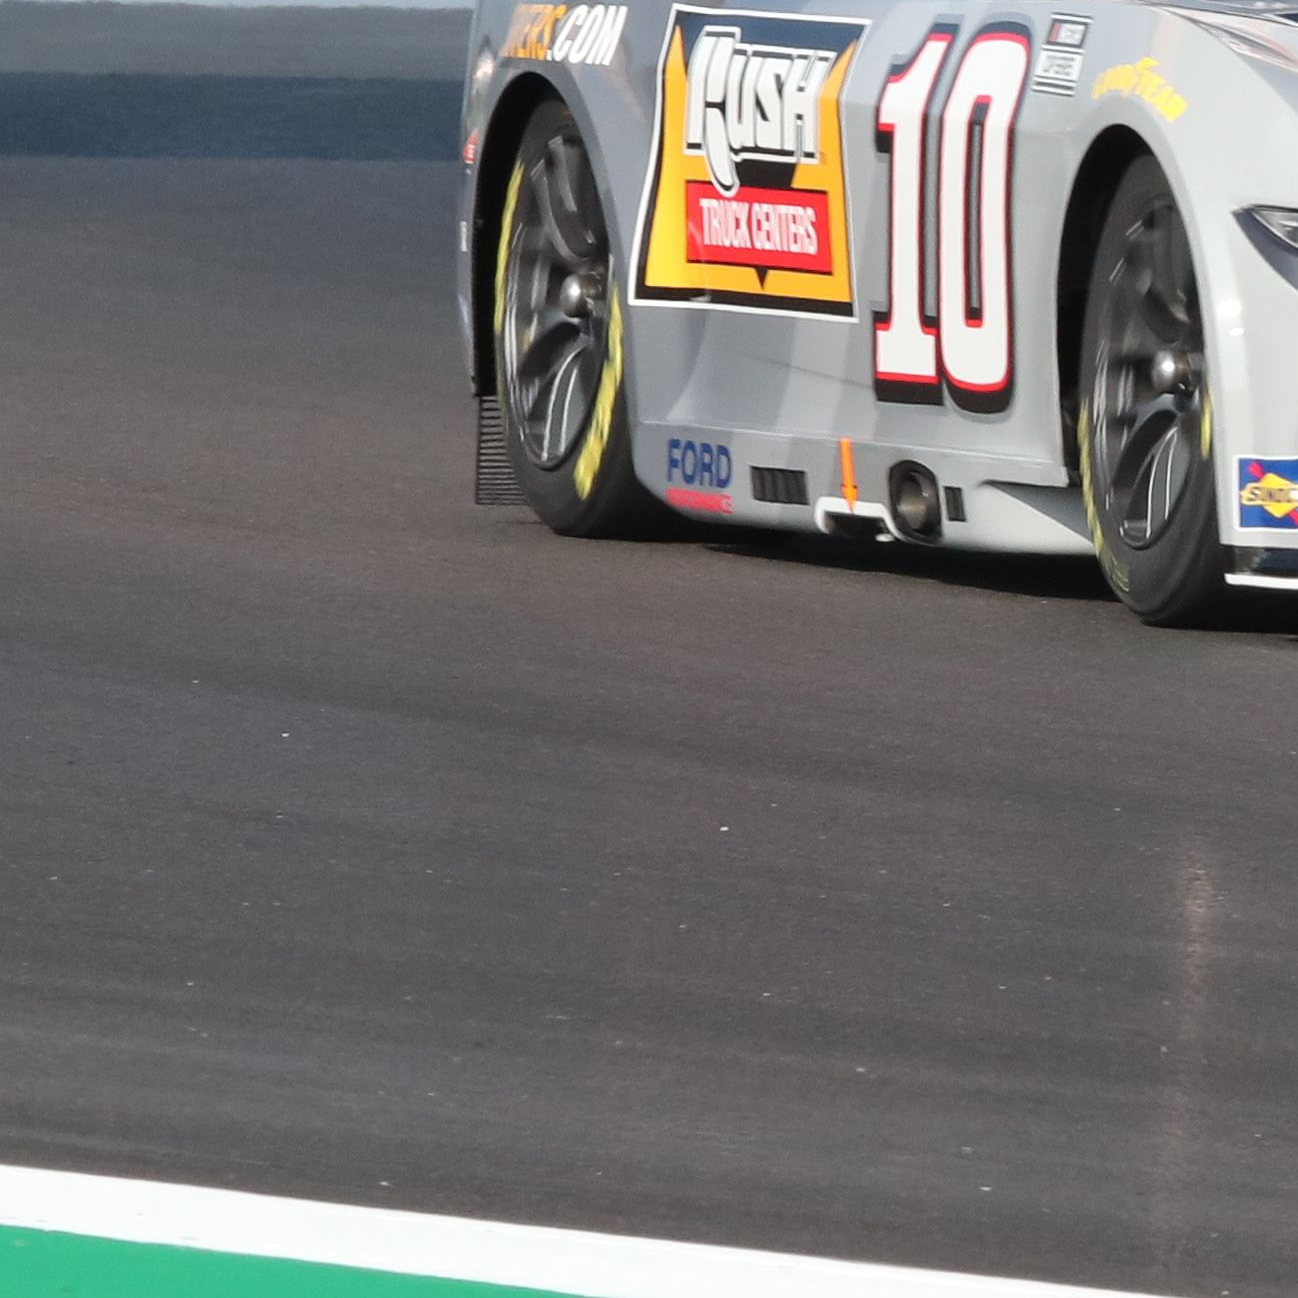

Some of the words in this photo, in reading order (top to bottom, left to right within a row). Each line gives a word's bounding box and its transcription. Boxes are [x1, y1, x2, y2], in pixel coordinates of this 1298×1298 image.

[684, 25, 837, 198] RUSH
[1092, 56, 1188, 123] YEAR
[699, 197, 753, 250] TRUCK
[751, 202, 818, 256] CENTERS
[874, 21, 1034, 414] 10
[666, 437, 732, 489] FORD
